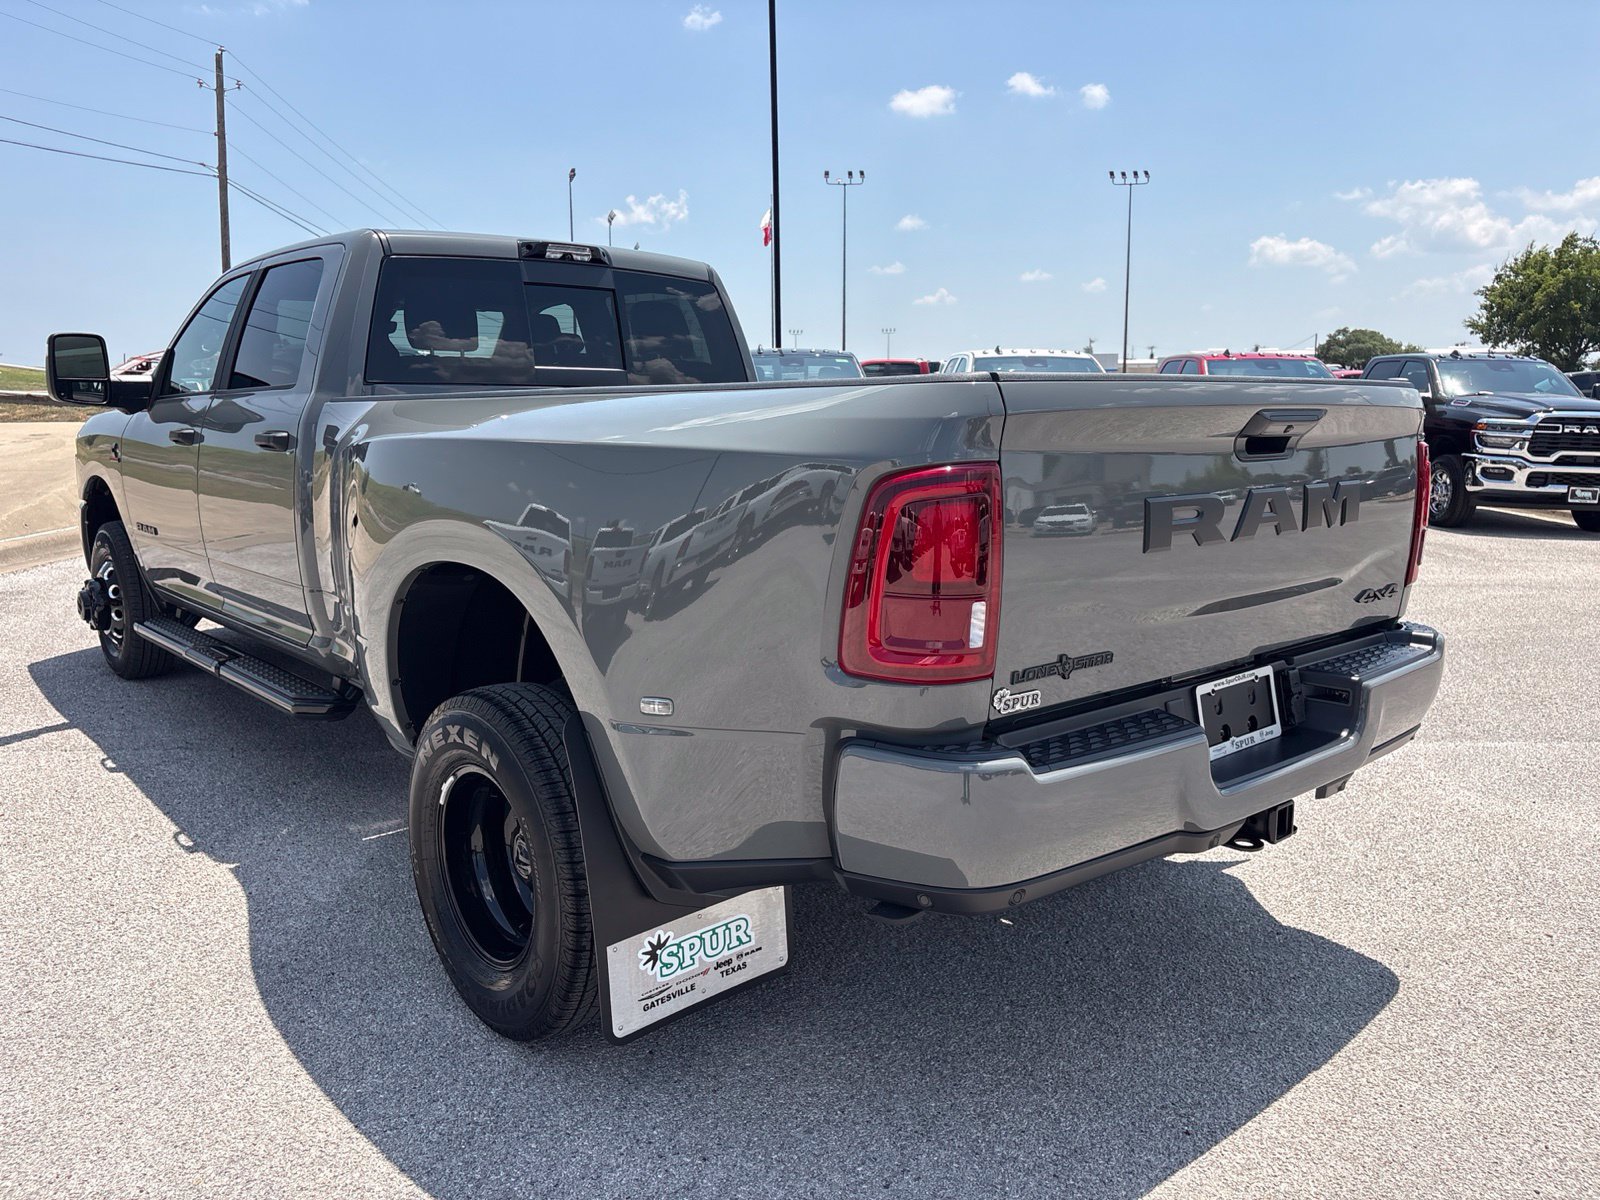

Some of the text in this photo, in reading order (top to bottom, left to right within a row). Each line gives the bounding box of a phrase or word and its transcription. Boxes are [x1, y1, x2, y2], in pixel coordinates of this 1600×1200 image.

[136, 521, 159, 536] RAM
[1142, 480, 1361, 554] RAM
[1010, 650, 1114, 686] LONE STAR
[1002, 693, 1040, 712] SPUR
[419, 724, 499, 772] NEXEN
[1235, 736, 1256, 750] SPUR
[659, 917, 752, 978] SPUR
[713, 957, 734, 971] Jeep
[642, 961, 748, 1012] GATESVILLE TEXAS
